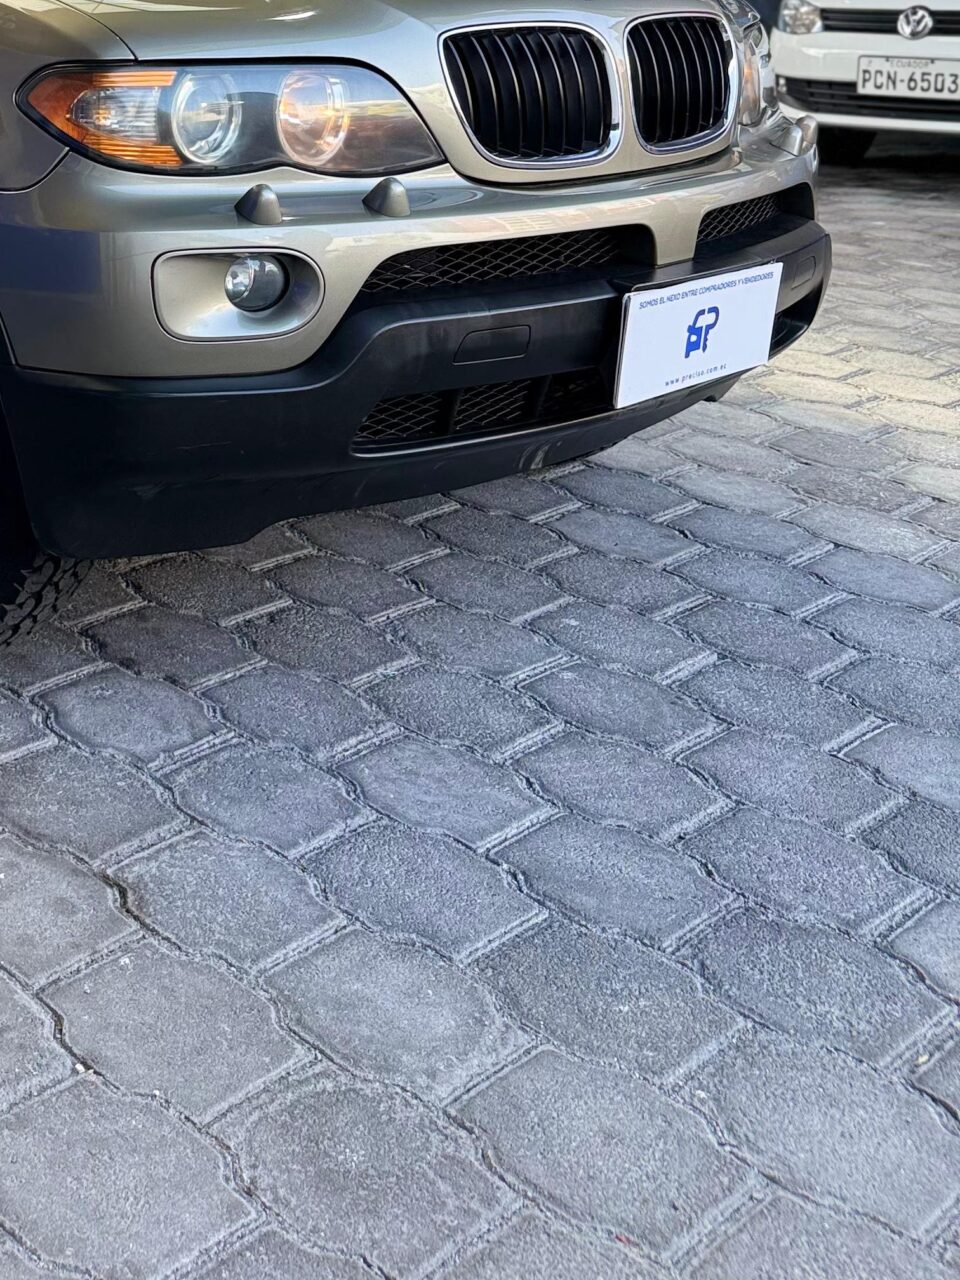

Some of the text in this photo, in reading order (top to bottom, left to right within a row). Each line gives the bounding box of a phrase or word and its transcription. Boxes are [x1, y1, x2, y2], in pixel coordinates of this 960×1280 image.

[861, 69, 959, 94] PCN-6503
[639, 298, 659, 309] SOMOS
[666, 292, 681, 301] NEXO
[681, 289, 698, 299] ENTRE
[699, 280, 737, 295] COMPRADORES
[740, 271, 774, 285] VENDEDORES
